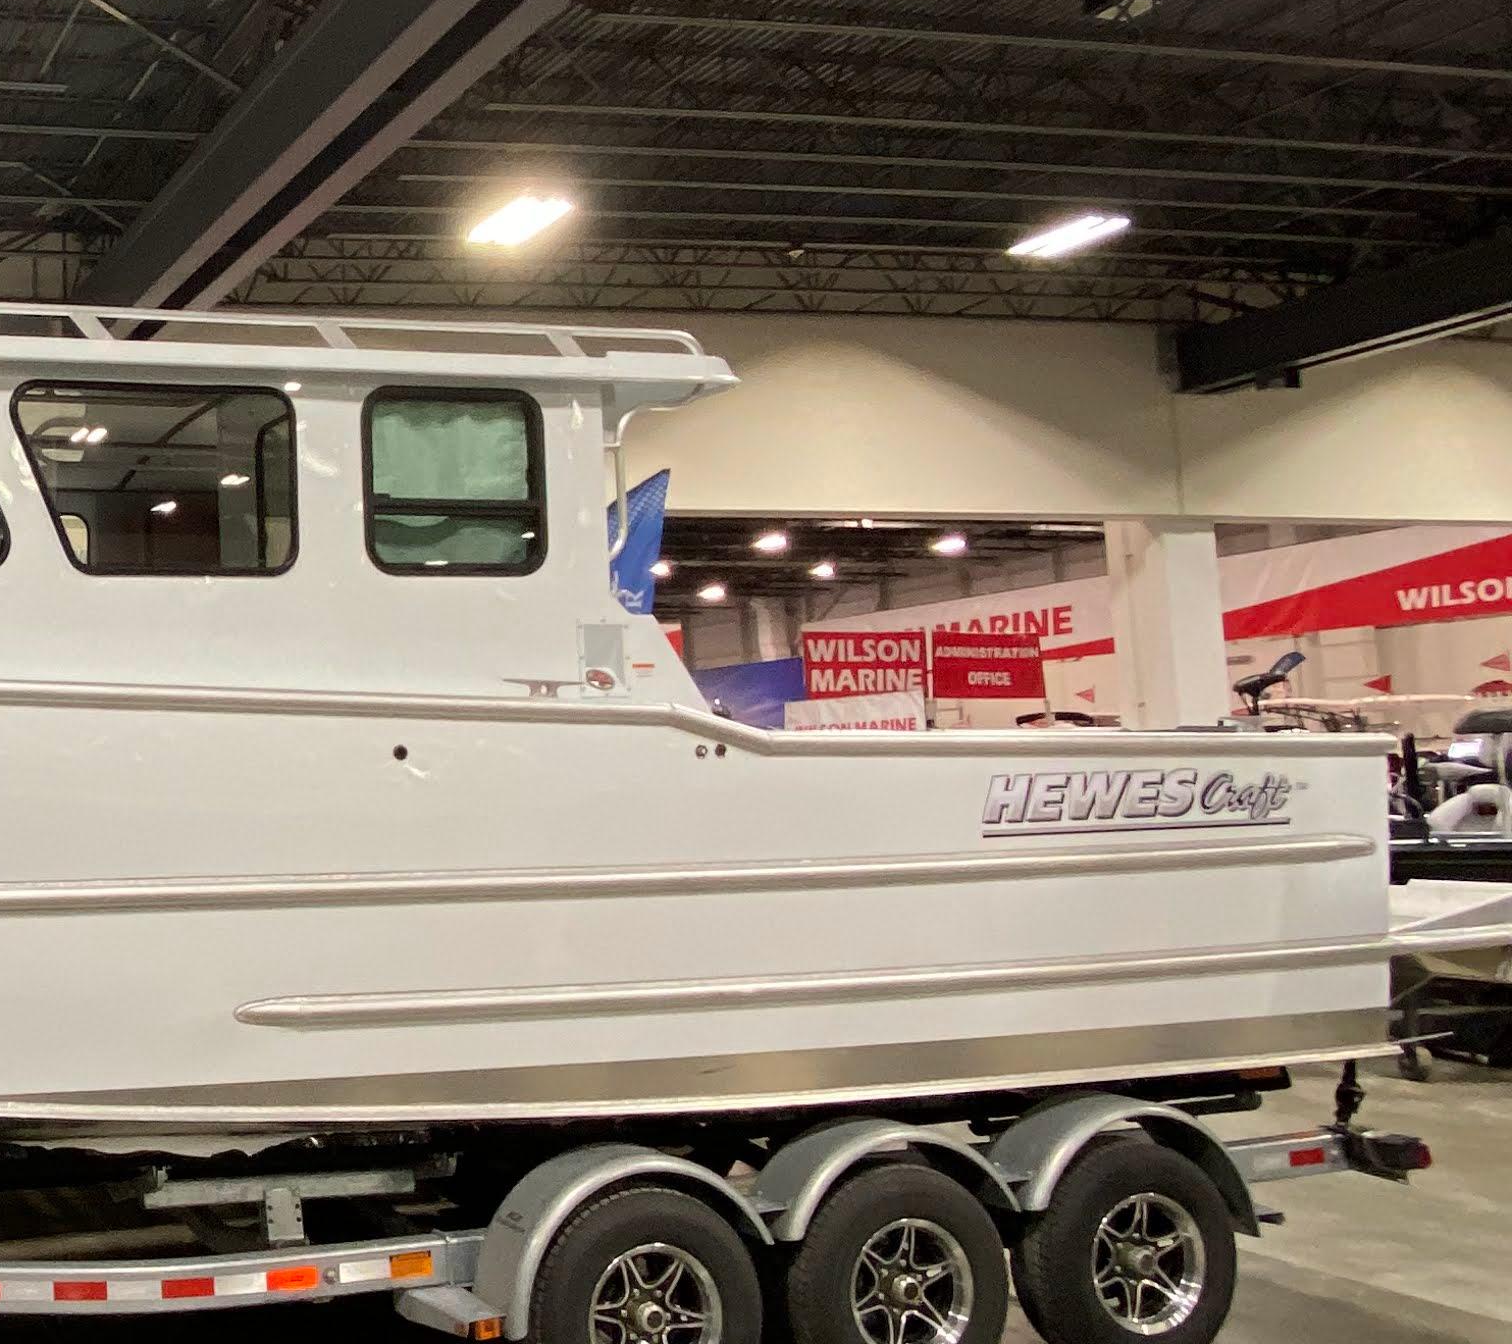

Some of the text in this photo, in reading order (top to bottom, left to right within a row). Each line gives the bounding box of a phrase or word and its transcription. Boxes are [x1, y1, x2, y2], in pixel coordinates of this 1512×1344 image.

[806, 637, 922, 663] WILSON
[935, 645, 1039, 659] ADMINISTRATION
[810, 667, 924, 693] MARINE
[967, 670, 1012, 687] OFFICE
